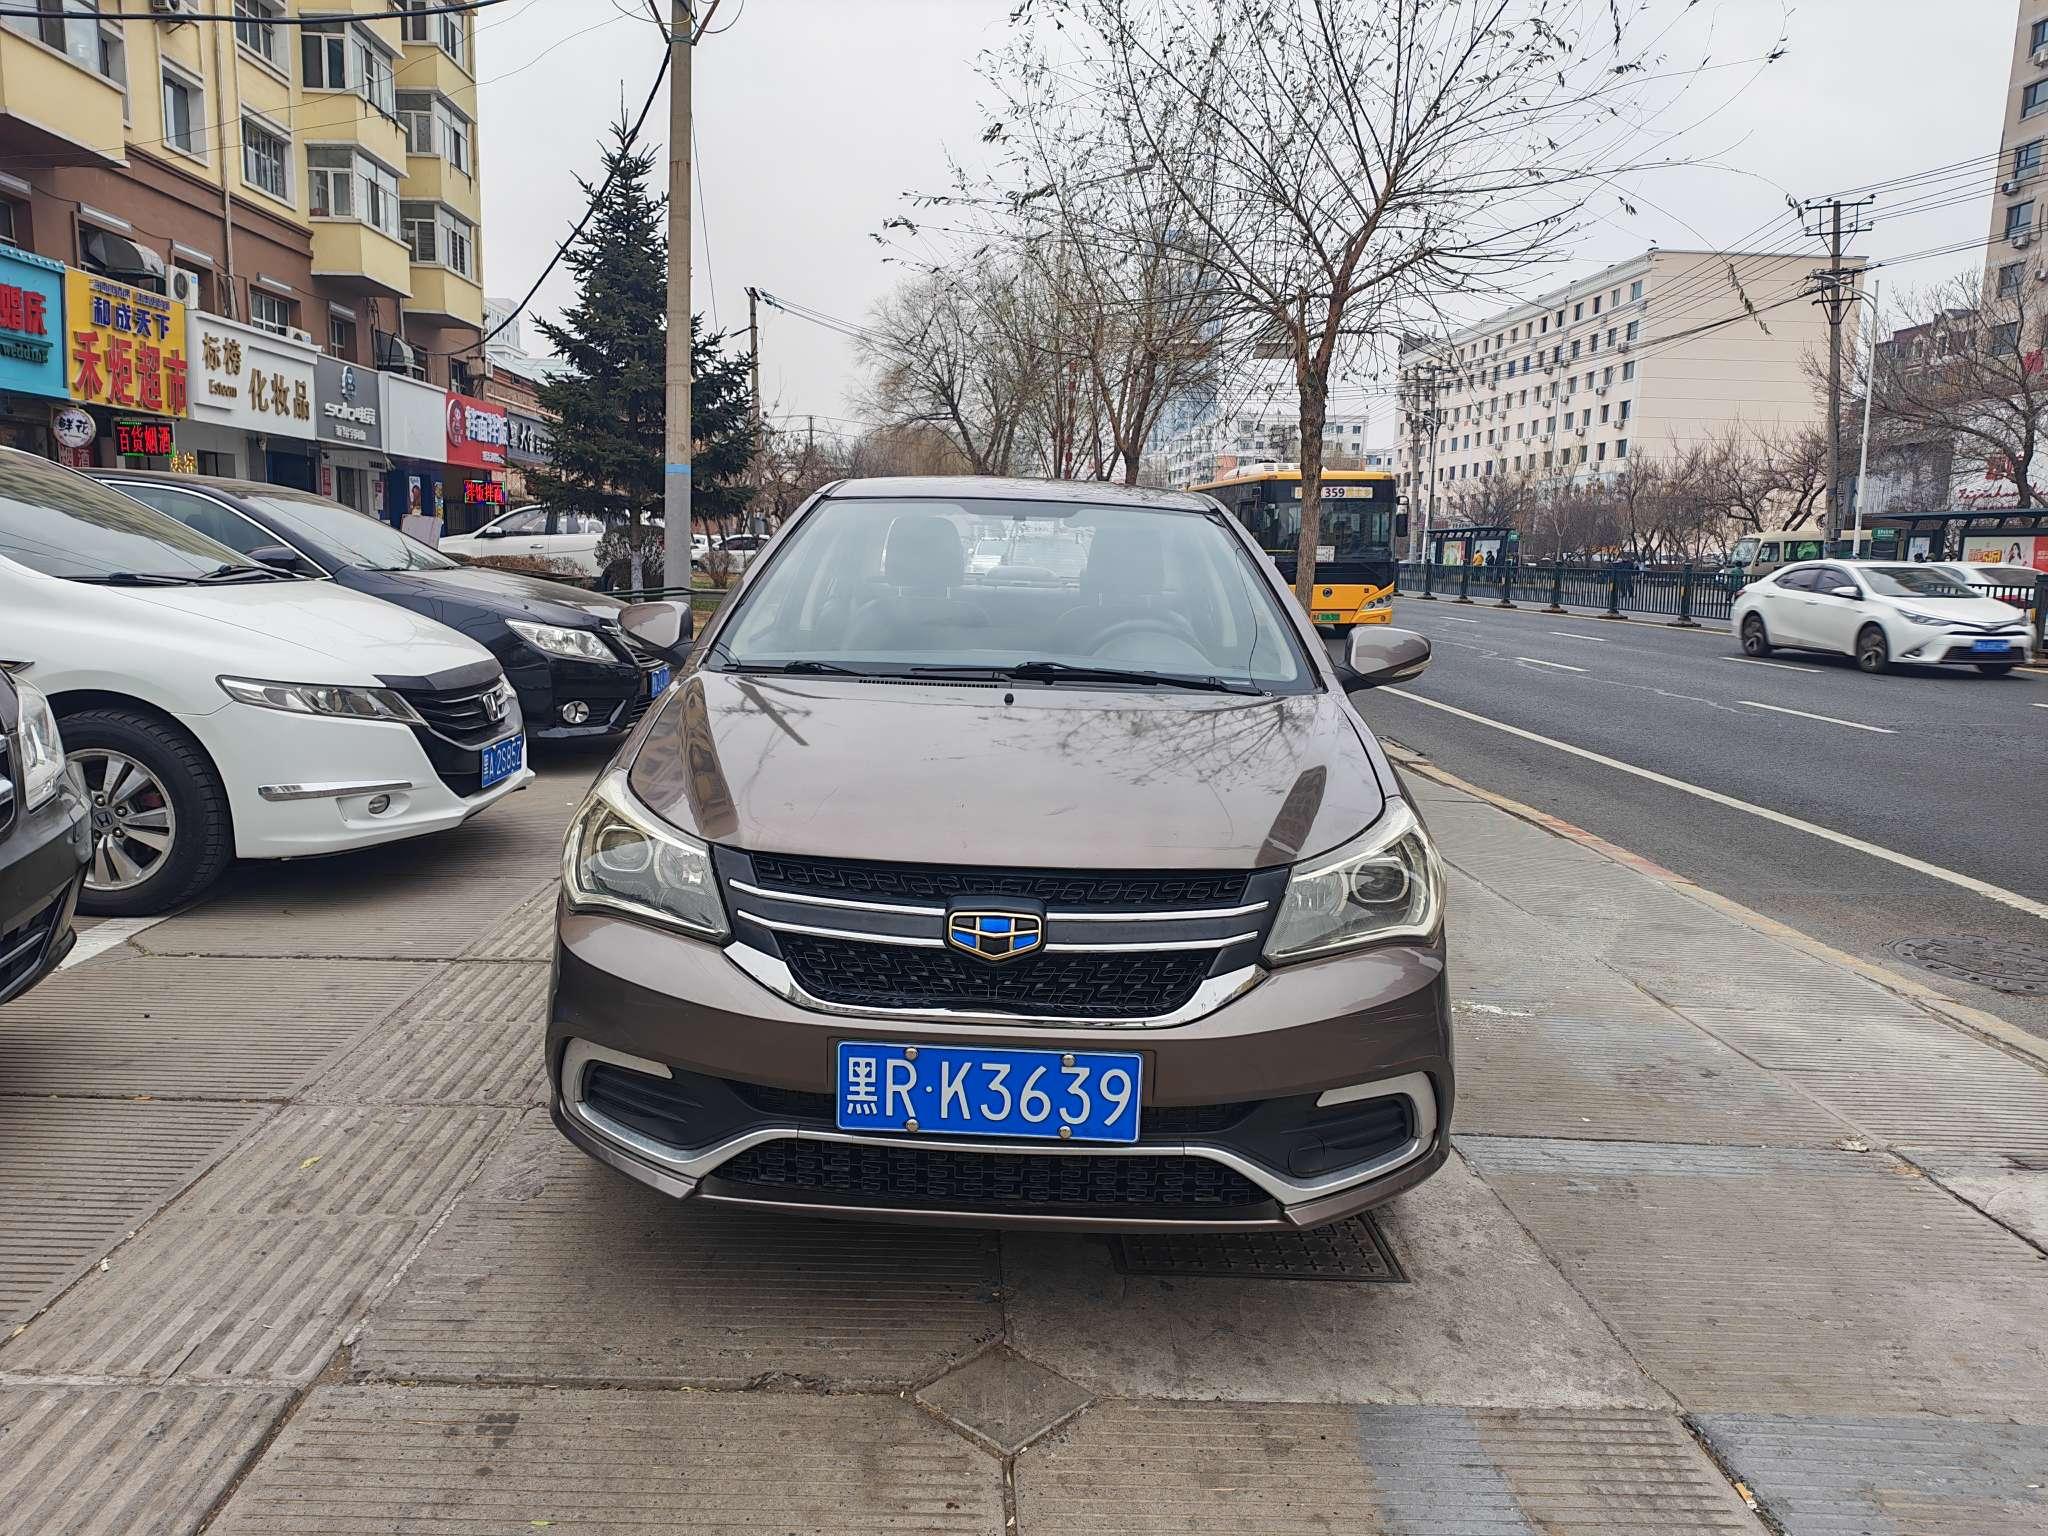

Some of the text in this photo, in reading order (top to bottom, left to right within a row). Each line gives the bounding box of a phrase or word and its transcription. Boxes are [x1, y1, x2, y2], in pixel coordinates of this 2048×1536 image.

[92, 296, 170, 340] 和成天下
[73, 331, 188, 414] 禾炬超市
[202, 332, 241, 375] 标榜
[248, 368, 310, 422] 化妆品
[58, 416, 89, 435] 鲜花
[117, 425, 172, 454] 百货烟酒
[1324, 488, 1345, 498] 359
